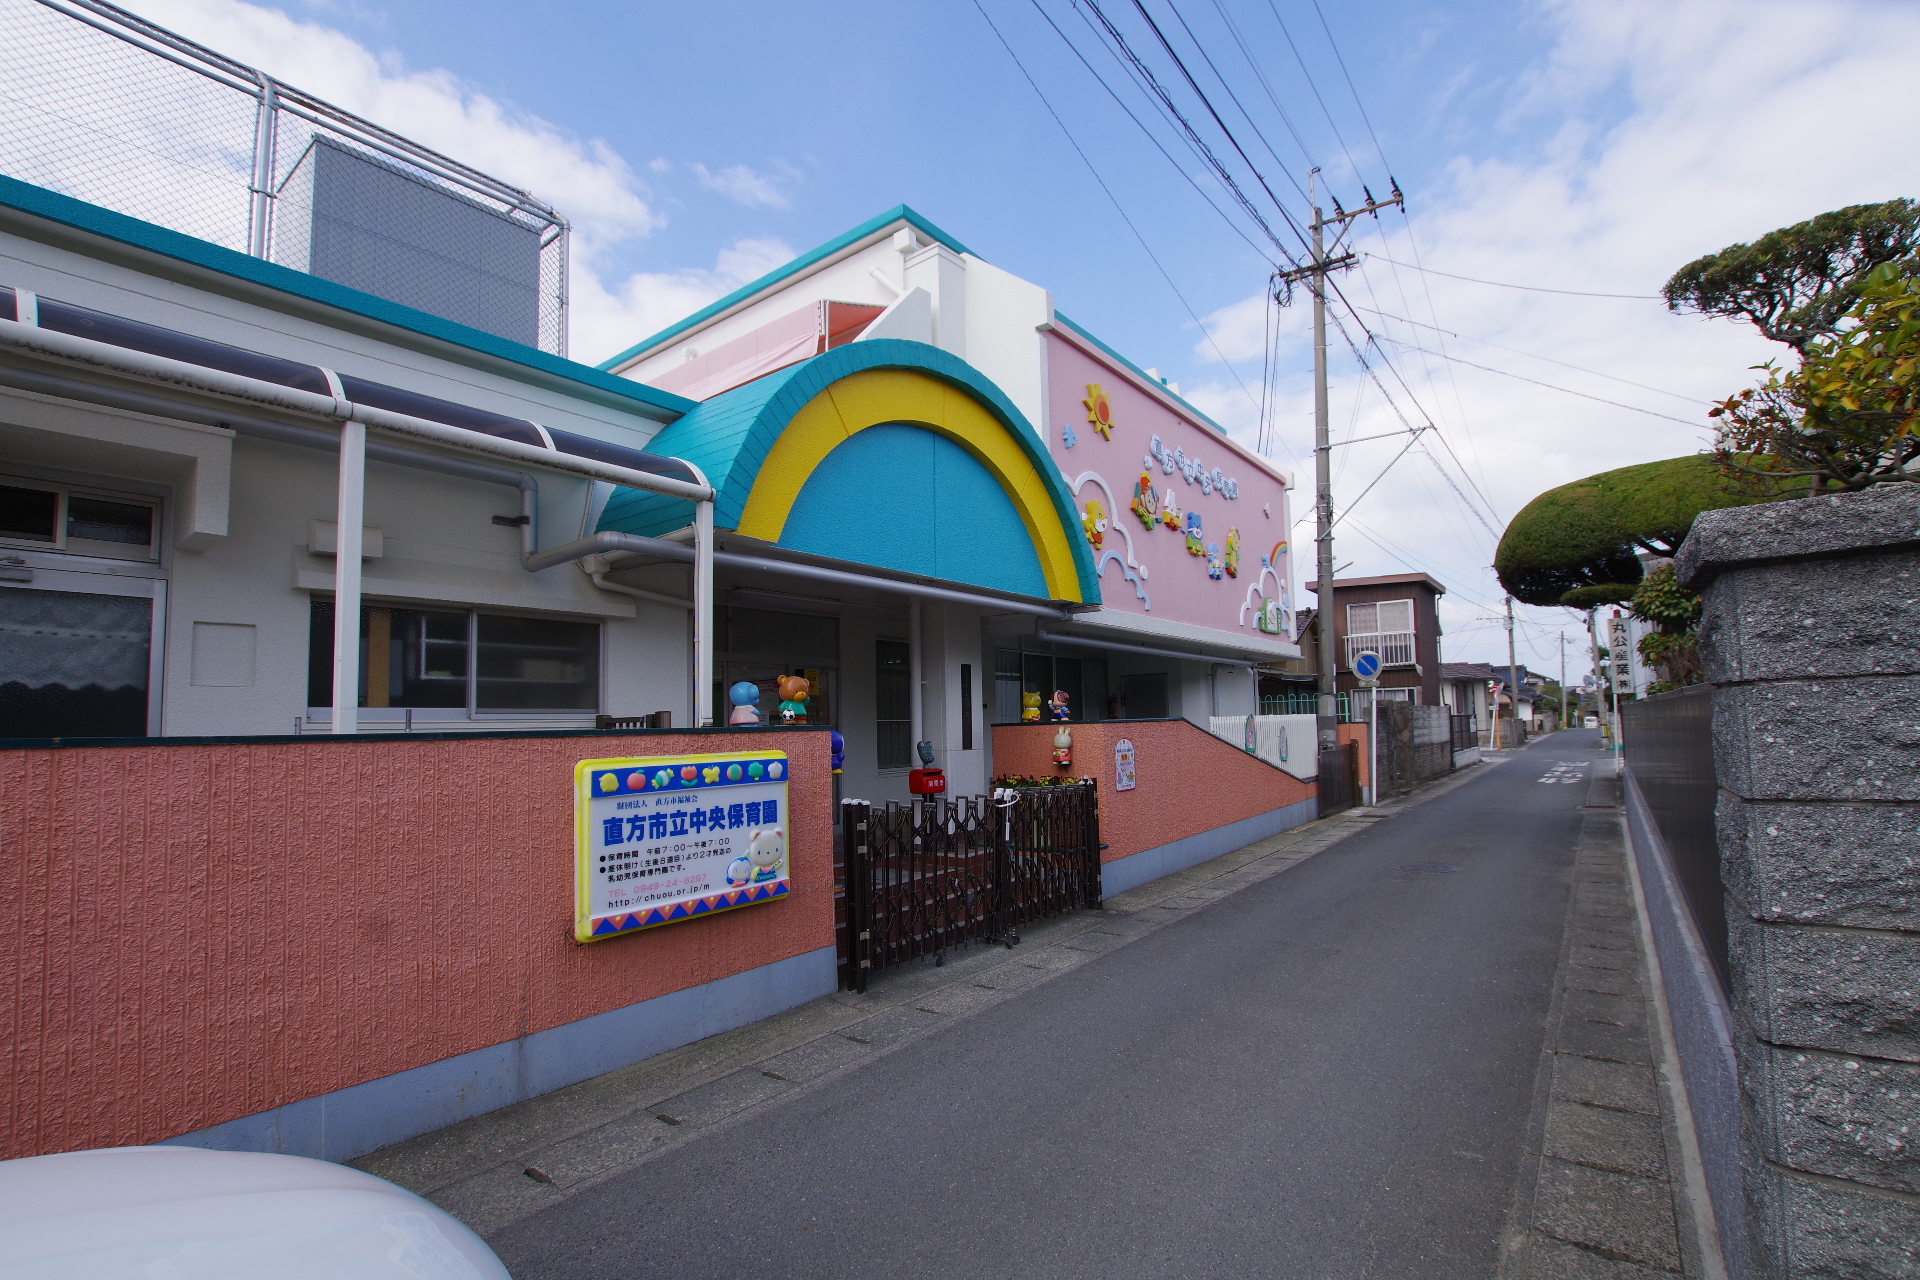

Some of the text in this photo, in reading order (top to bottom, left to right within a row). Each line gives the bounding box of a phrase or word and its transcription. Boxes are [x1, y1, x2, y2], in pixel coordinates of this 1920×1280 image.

[616, 794, 699, 810] 財団法人 直方市福祉会
[603, 799, 778, 847] 直方市立中央保育園
[607, 850, 639, 862] 保育時間
[608, 873, 707, 898] TEL 0949-24-6297
